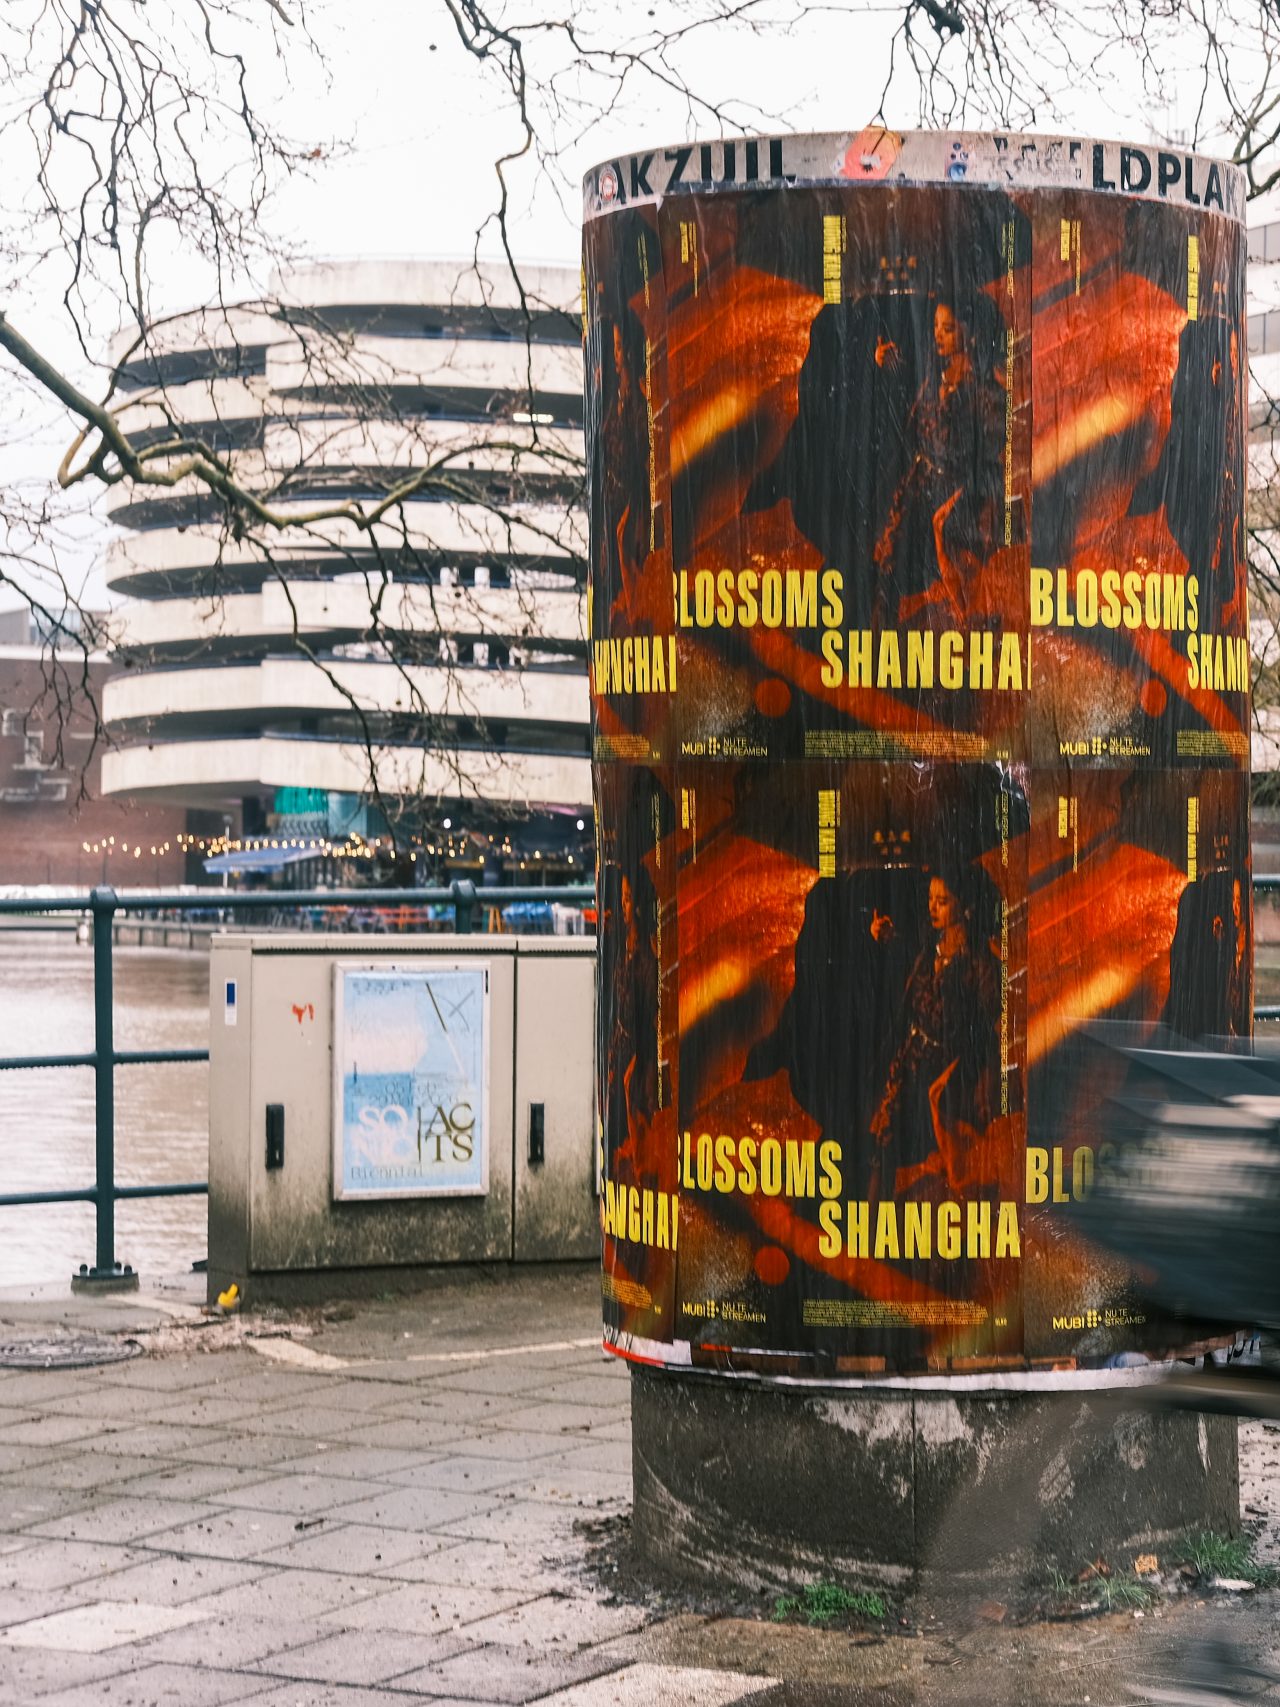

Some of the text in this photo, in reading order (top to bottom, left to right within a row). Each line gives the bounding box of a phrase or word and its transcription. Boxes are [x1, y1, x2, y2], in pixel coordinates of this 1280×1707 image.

[673, 569, 844, 629] LOSSOMS
[1030, 567, 1199, 633] BLOSSOMS
[592, 634, 677, 696] HANGHAI
[820, 629, 1032, 691] SHANGHA
[681, 742, 706, 756] MUBI
[1060, 742, 1090, 756] MUBI
[425, 1102, 475, 1137] AC
[425, 1134, 474, 1162] TS
[678, 1131, 843, 1200] LOSSOMS
[682, 1301, 706, 1317] MUBI
[1052, 1317, 1085, 1330] MUBI
